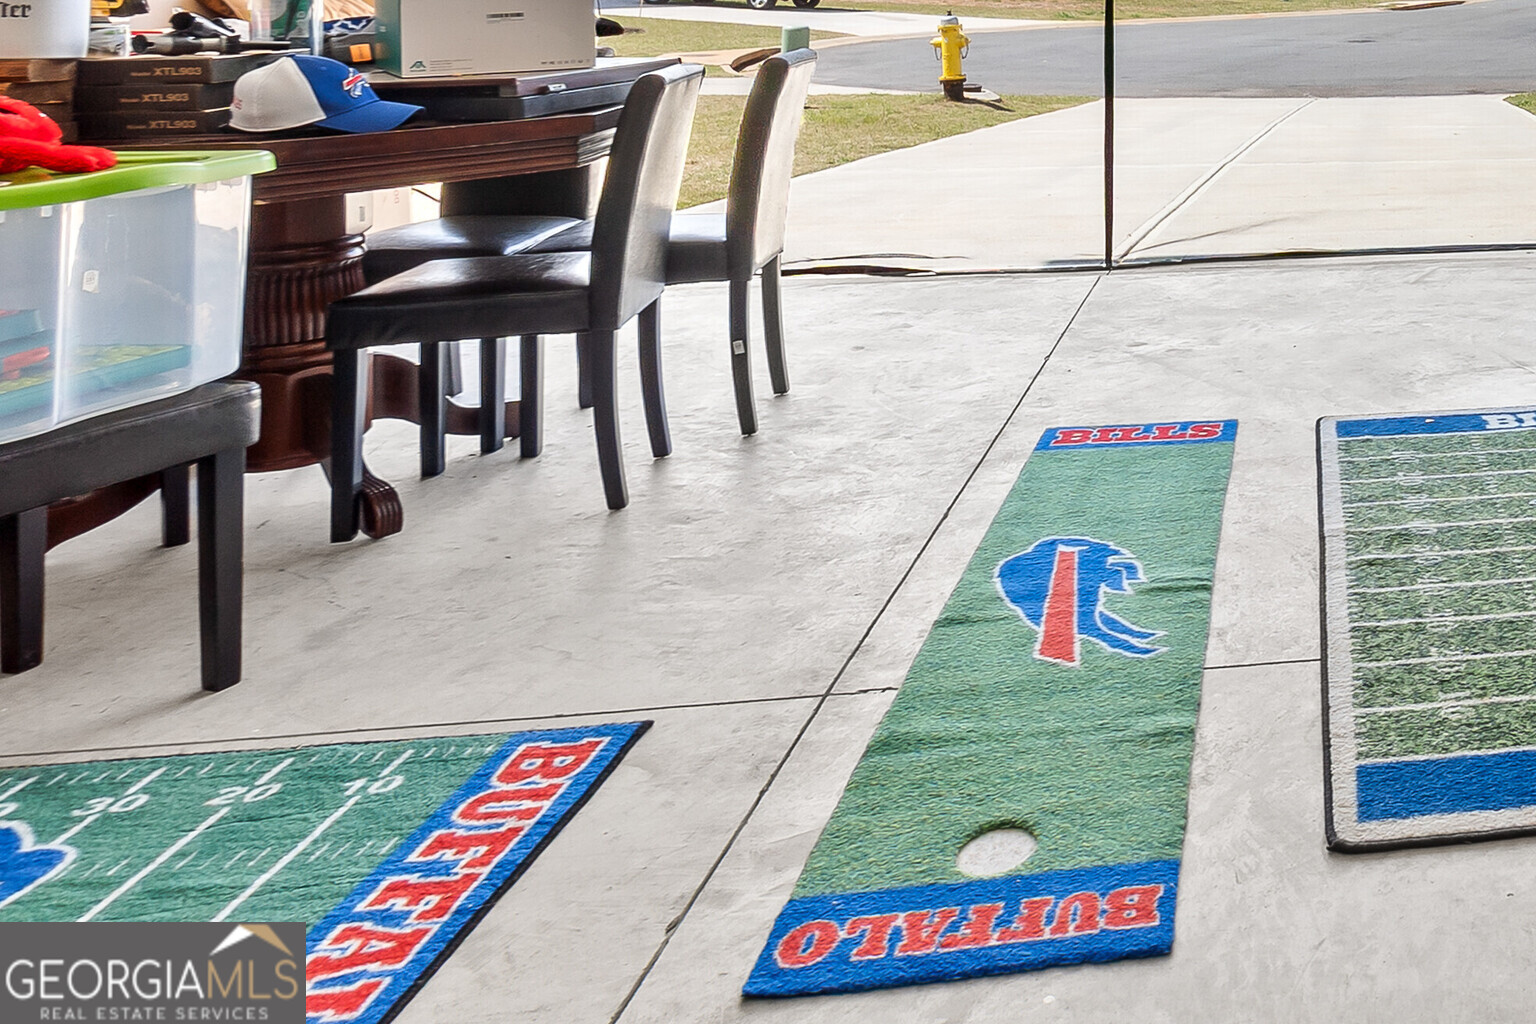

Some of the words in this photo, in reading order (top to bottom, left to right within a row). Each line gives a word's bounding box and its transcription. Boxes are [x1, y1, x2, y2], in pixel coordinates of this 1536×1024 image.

[1050, 422, 1224, 447] BILLS
[203, 782, 284, 806] 20
[343, 775, 405, 796] 10
[71, 794, 150, 817] 30
[772, 883, 1164, 969] BUFFALO
